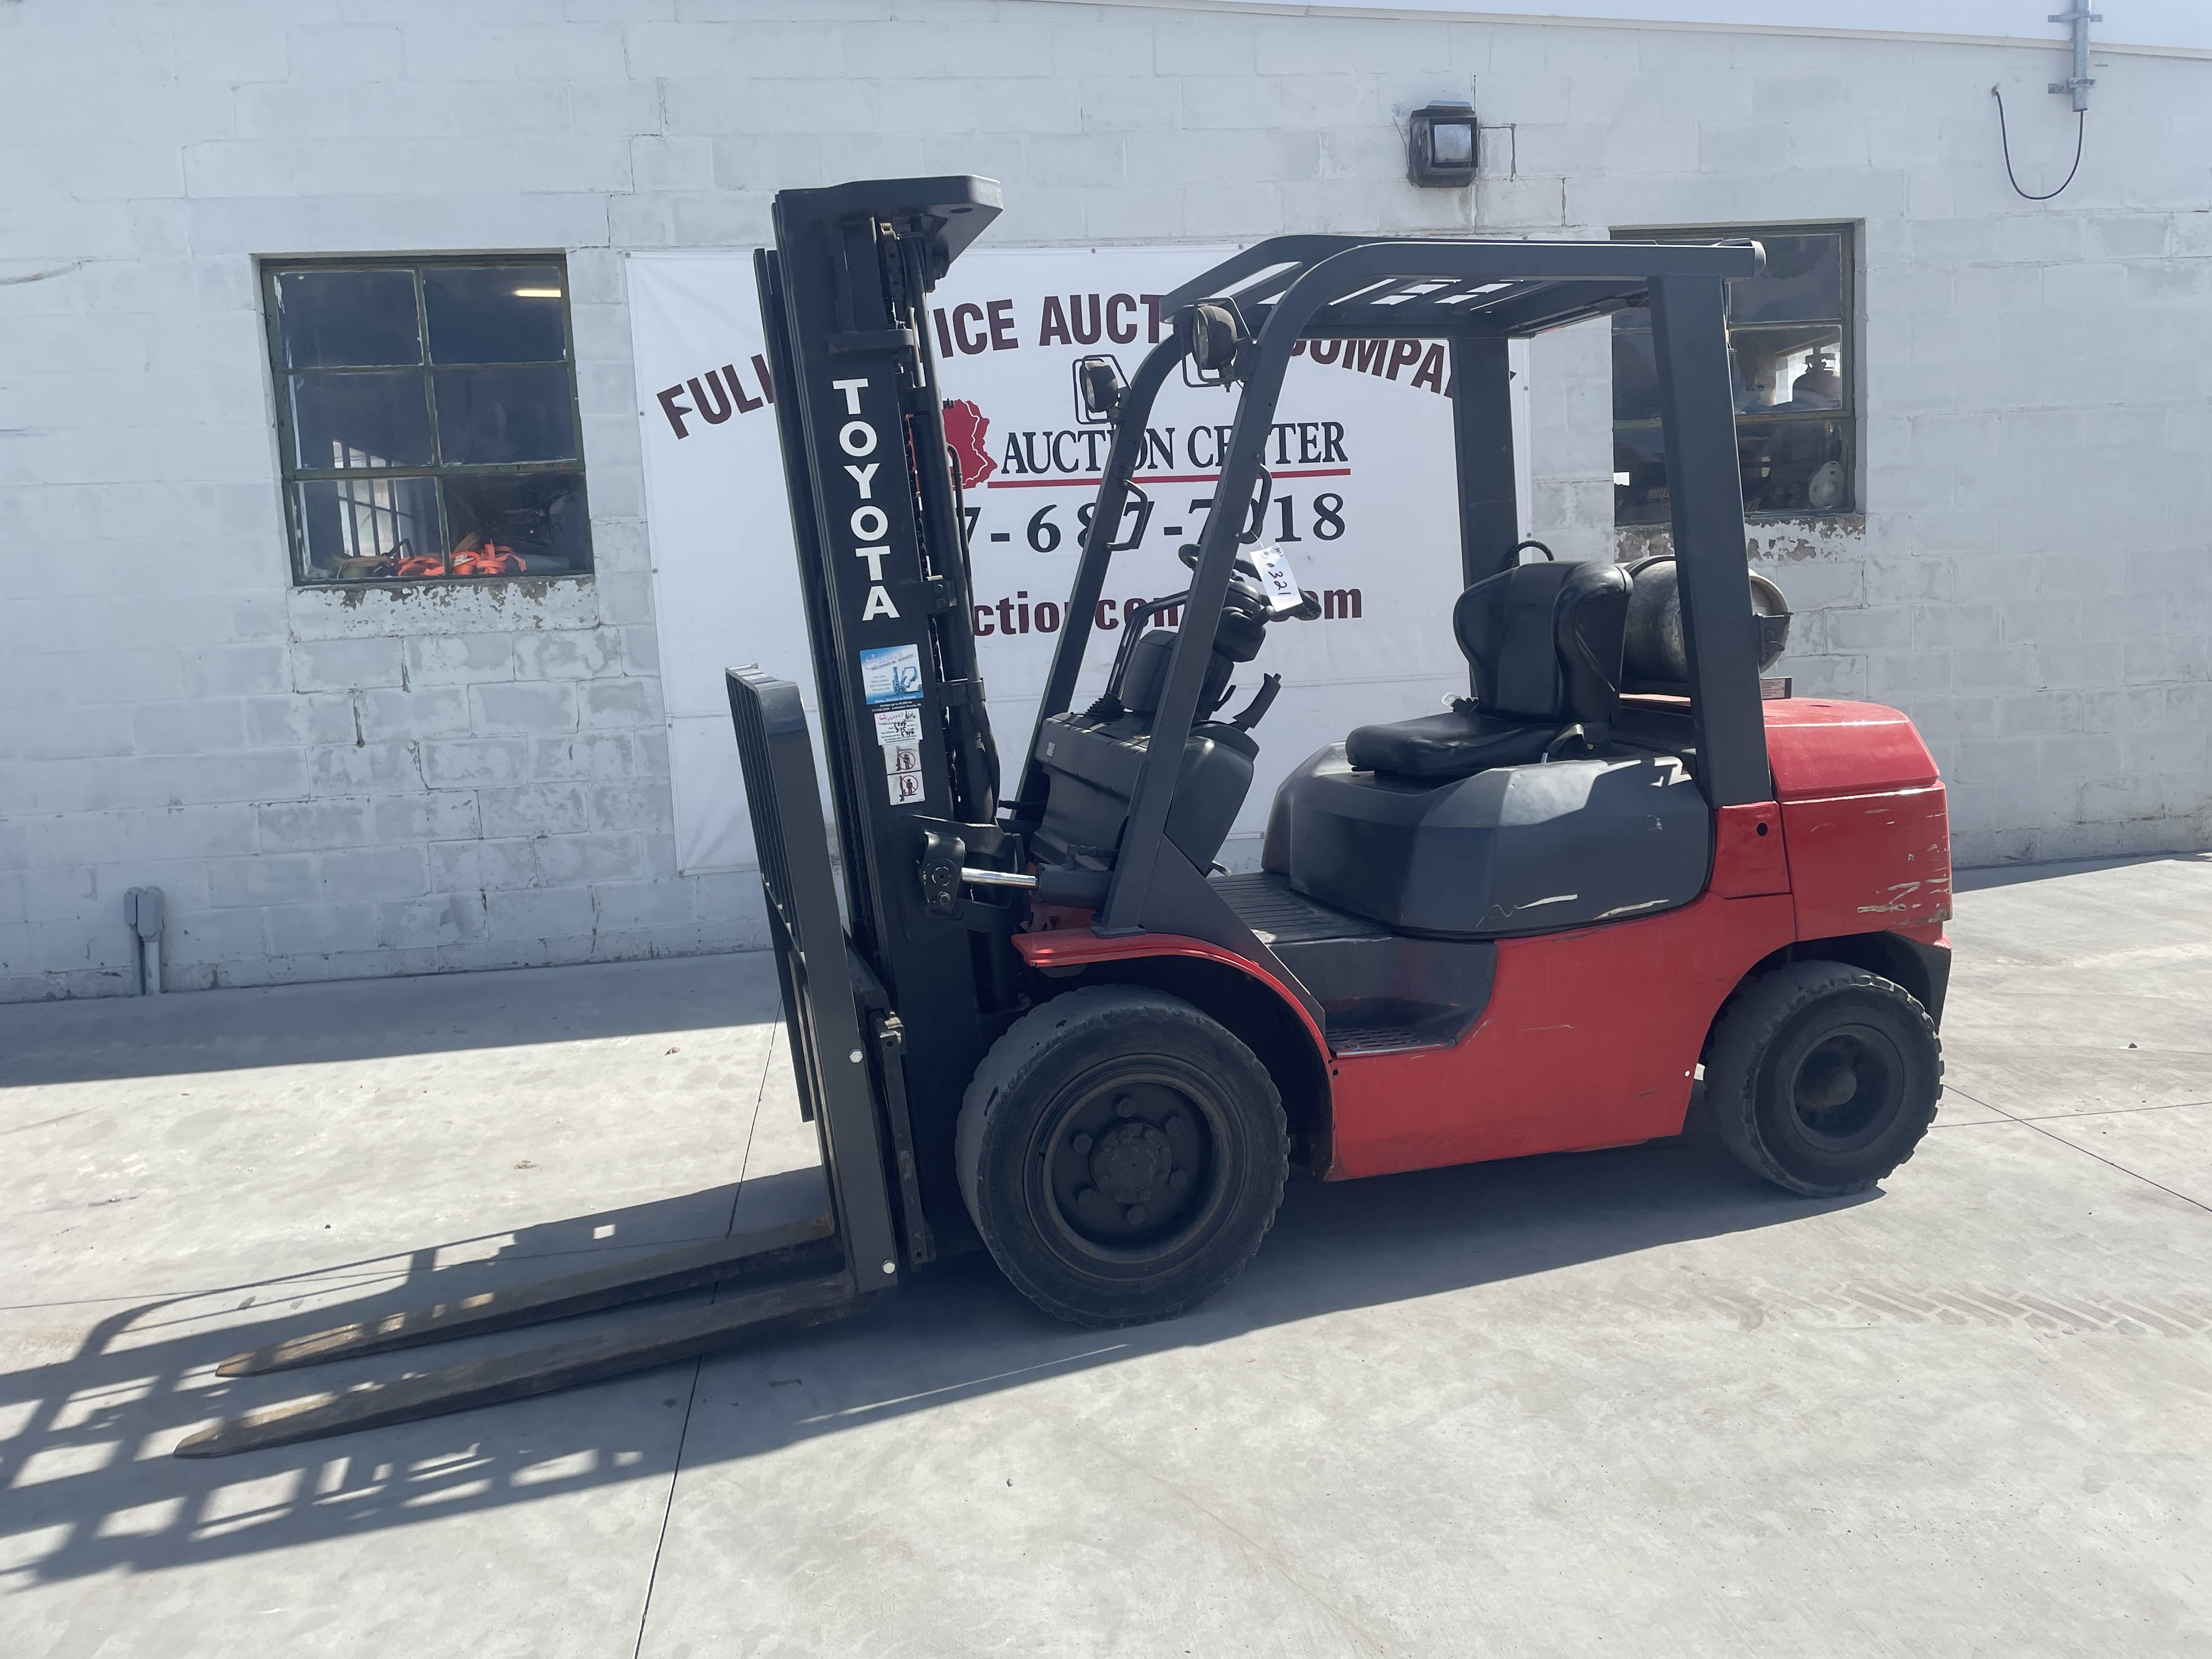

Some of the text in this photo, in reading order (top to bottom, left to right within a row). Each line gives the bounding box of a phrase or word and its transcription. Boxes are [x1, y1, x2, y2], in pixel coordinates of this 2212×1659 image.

[1039, 293, 1166, 346] AUCT
[1187, 422, 1348, 468] CETER
[832, 377, 900, 622] TOYOTA
